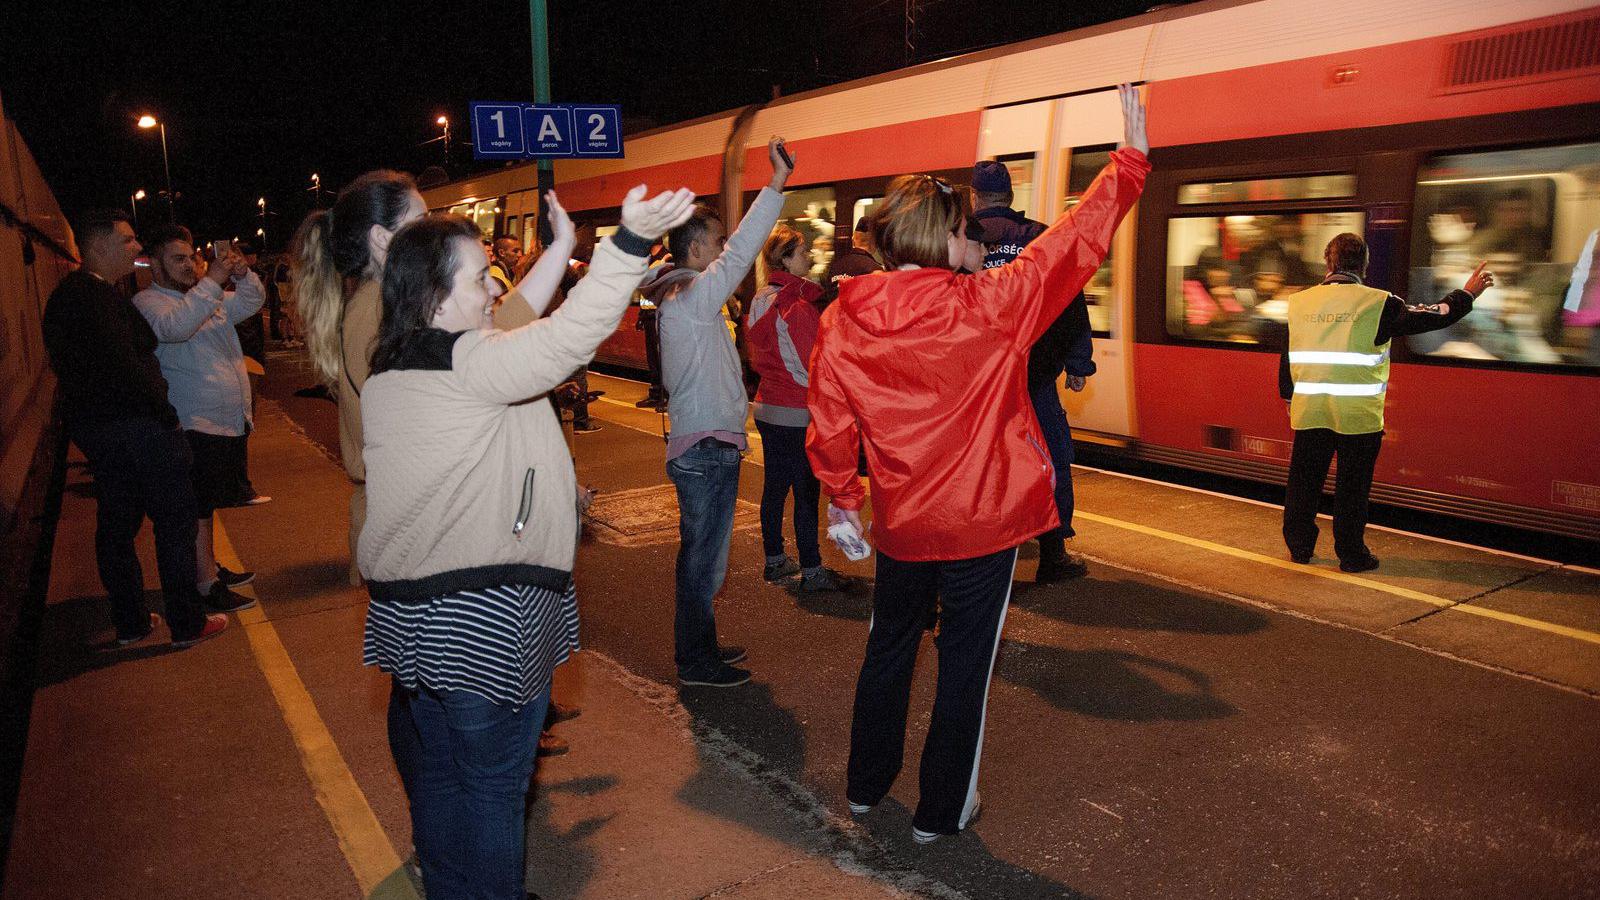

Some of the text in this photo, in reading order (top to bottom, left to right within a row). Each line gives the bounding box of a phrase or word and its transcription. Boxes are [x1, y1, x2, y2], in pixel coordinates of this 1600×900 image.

[491, 110, 505, 138] 1
[537, 114, 563, 141] A
[588, 113, 607, 140] 2
